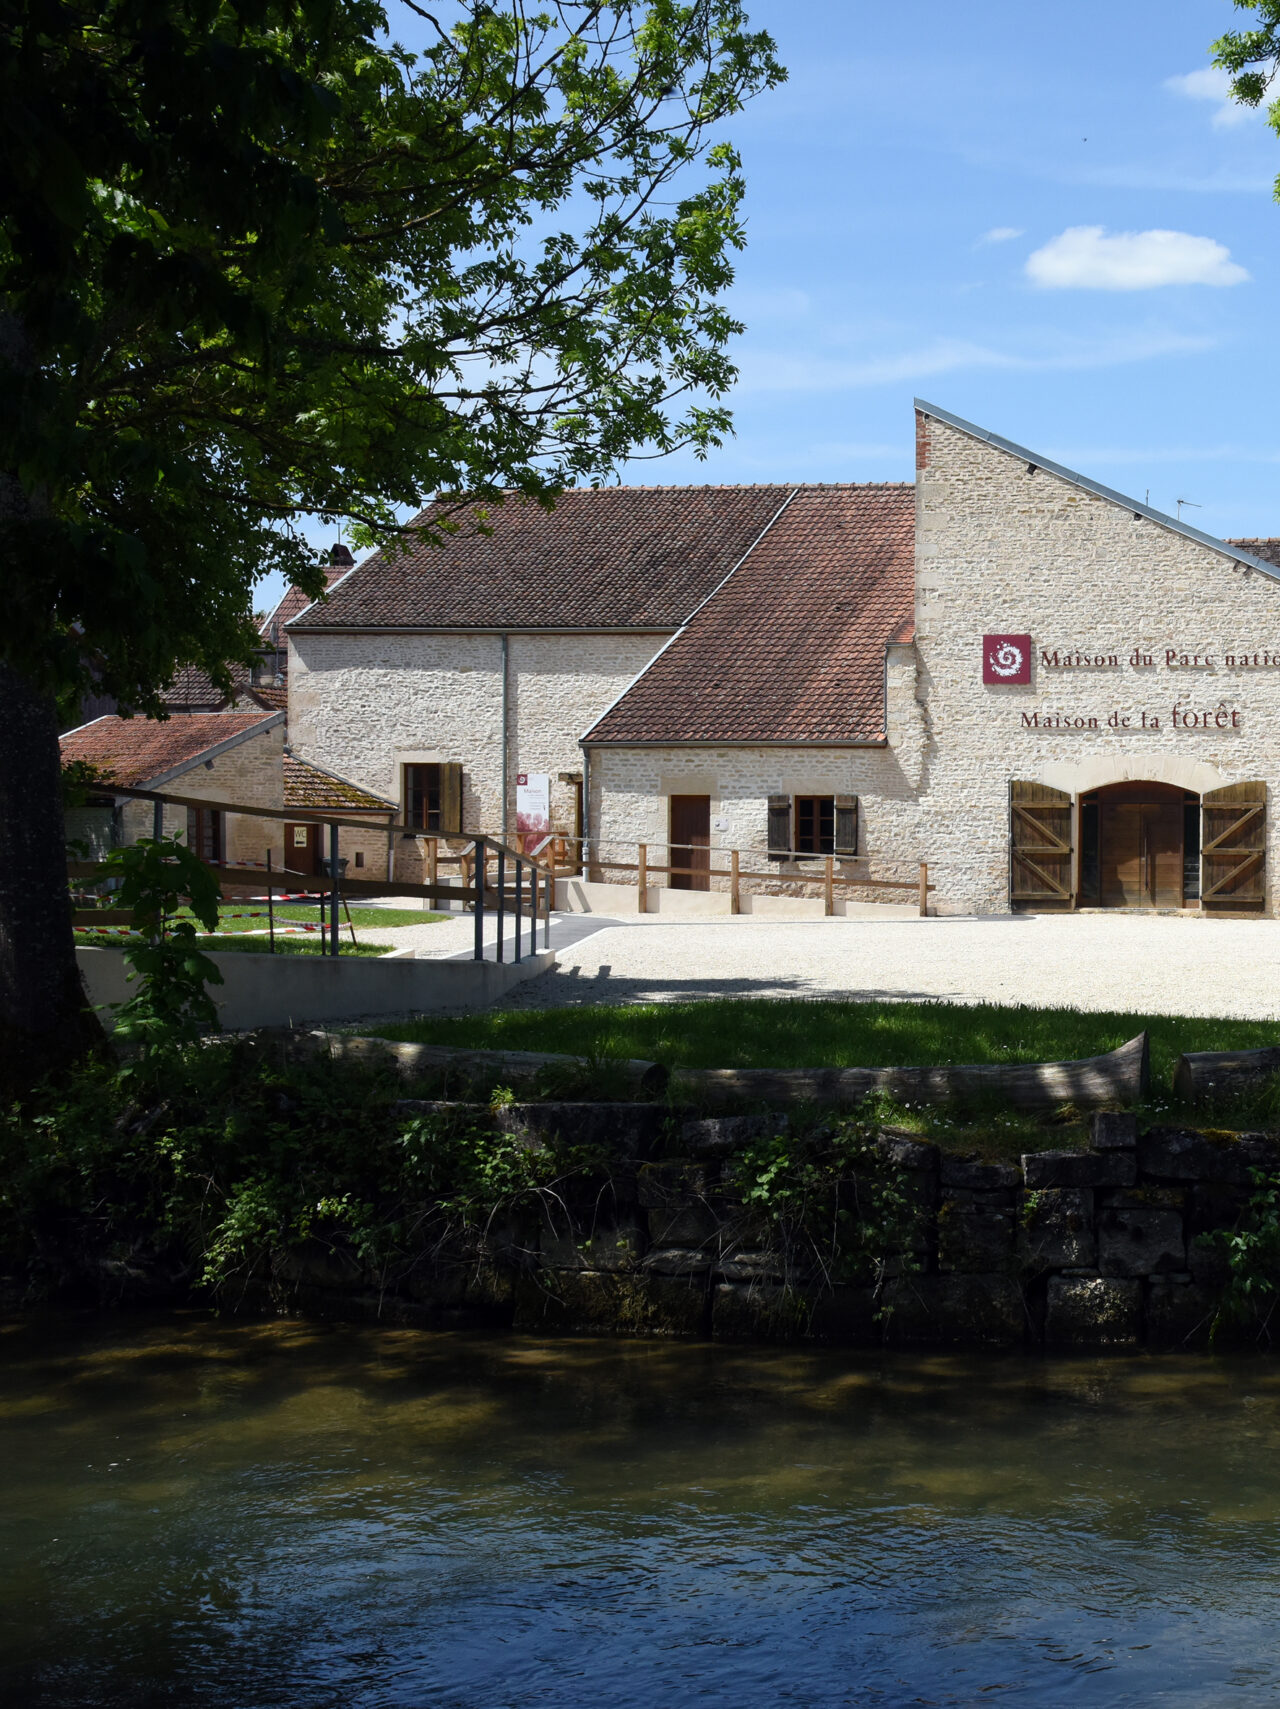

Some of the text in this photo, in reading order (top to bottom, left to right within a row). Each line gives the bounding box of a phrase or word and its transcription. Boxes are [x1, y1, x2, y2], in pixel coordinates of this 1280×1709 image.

[1041, 650, 1118, 667] Maison
[1129, 650, 1153, 667] du
[1165, 650, 1214, 667] Parc
[1020, 702, 1241, 729] Maison de la forêt
[295, 829, 306, 838] WC
